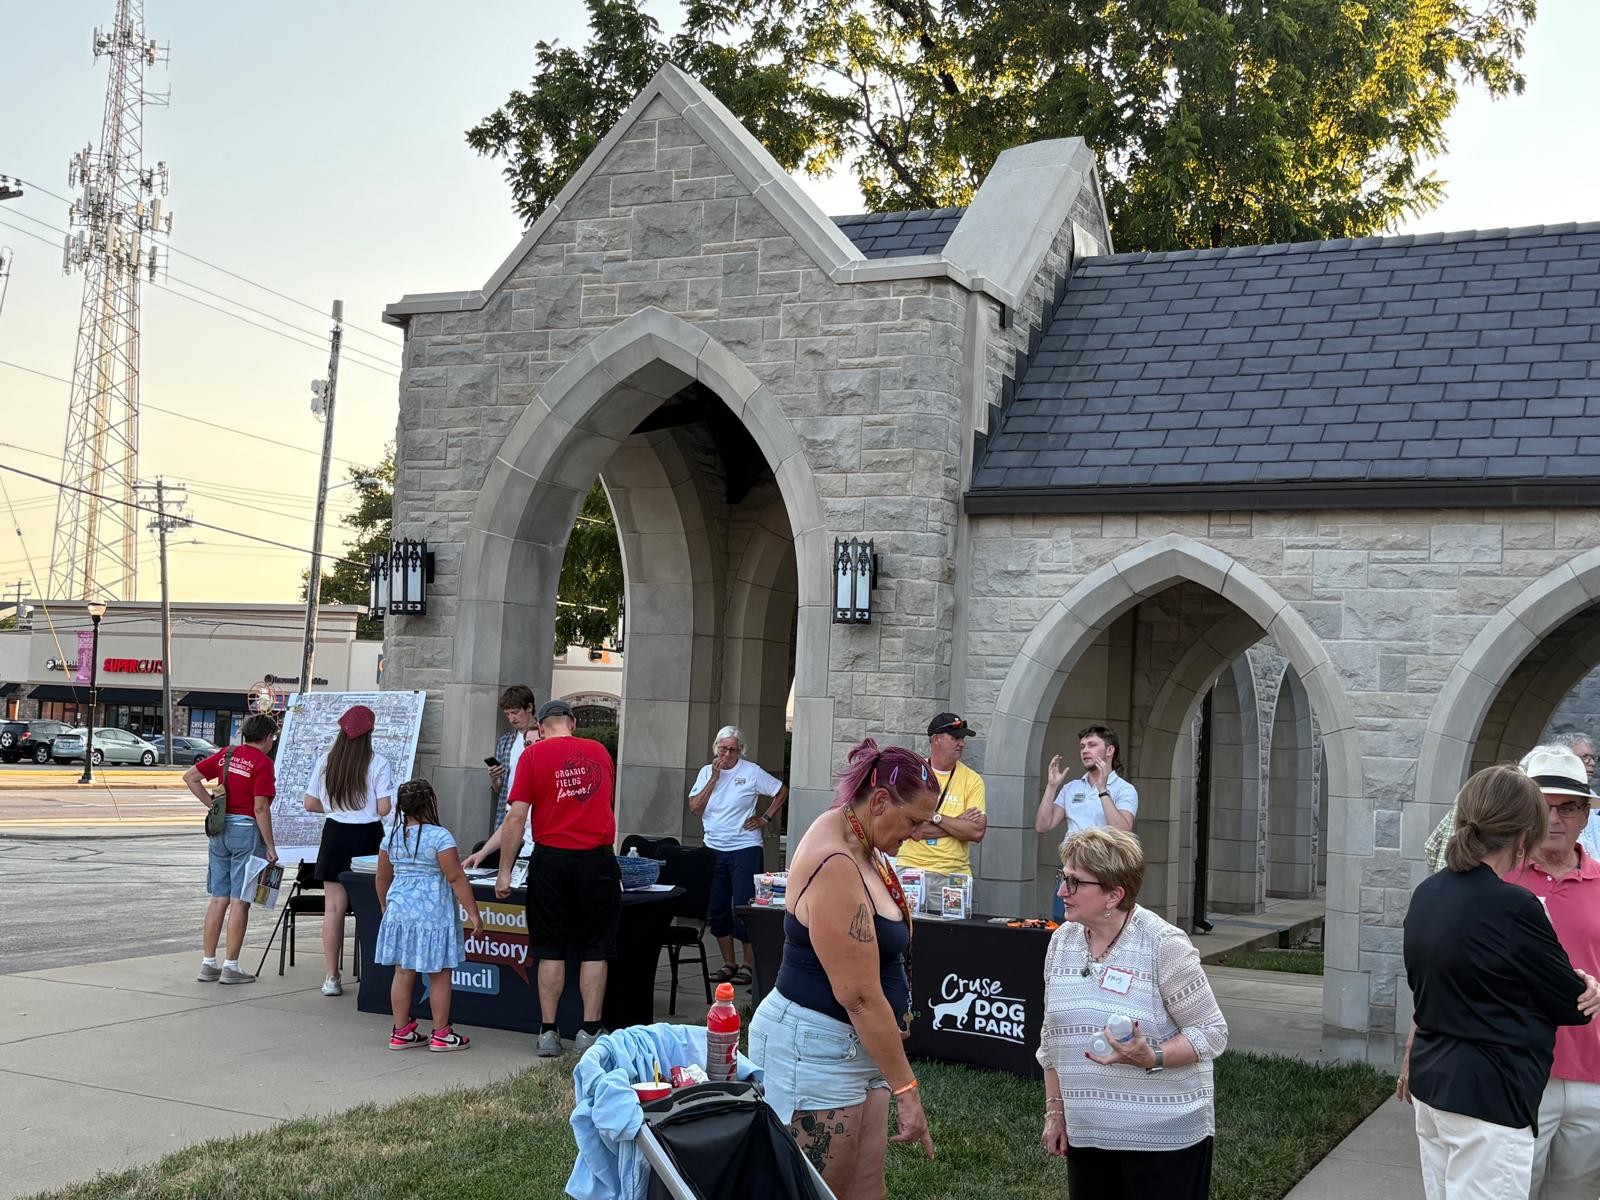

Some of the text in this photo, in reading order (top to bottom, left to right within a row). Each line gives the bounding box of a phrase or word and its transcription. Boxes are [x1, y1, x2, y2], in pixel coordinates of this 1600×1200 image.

[555, 767, 586, 778] ORGANIC
[556, 777, 581, 788] FIELDS
[459, 903, 527, 928] brhood
[465, 935, 529, 964] dvisory
[451, 968, 492, 989] uncil
[941, 973, 1003, 1000] Cruse
[975, 999, 1025, 1022] DOG
[974, 1017, 1025, 1039] PARK
